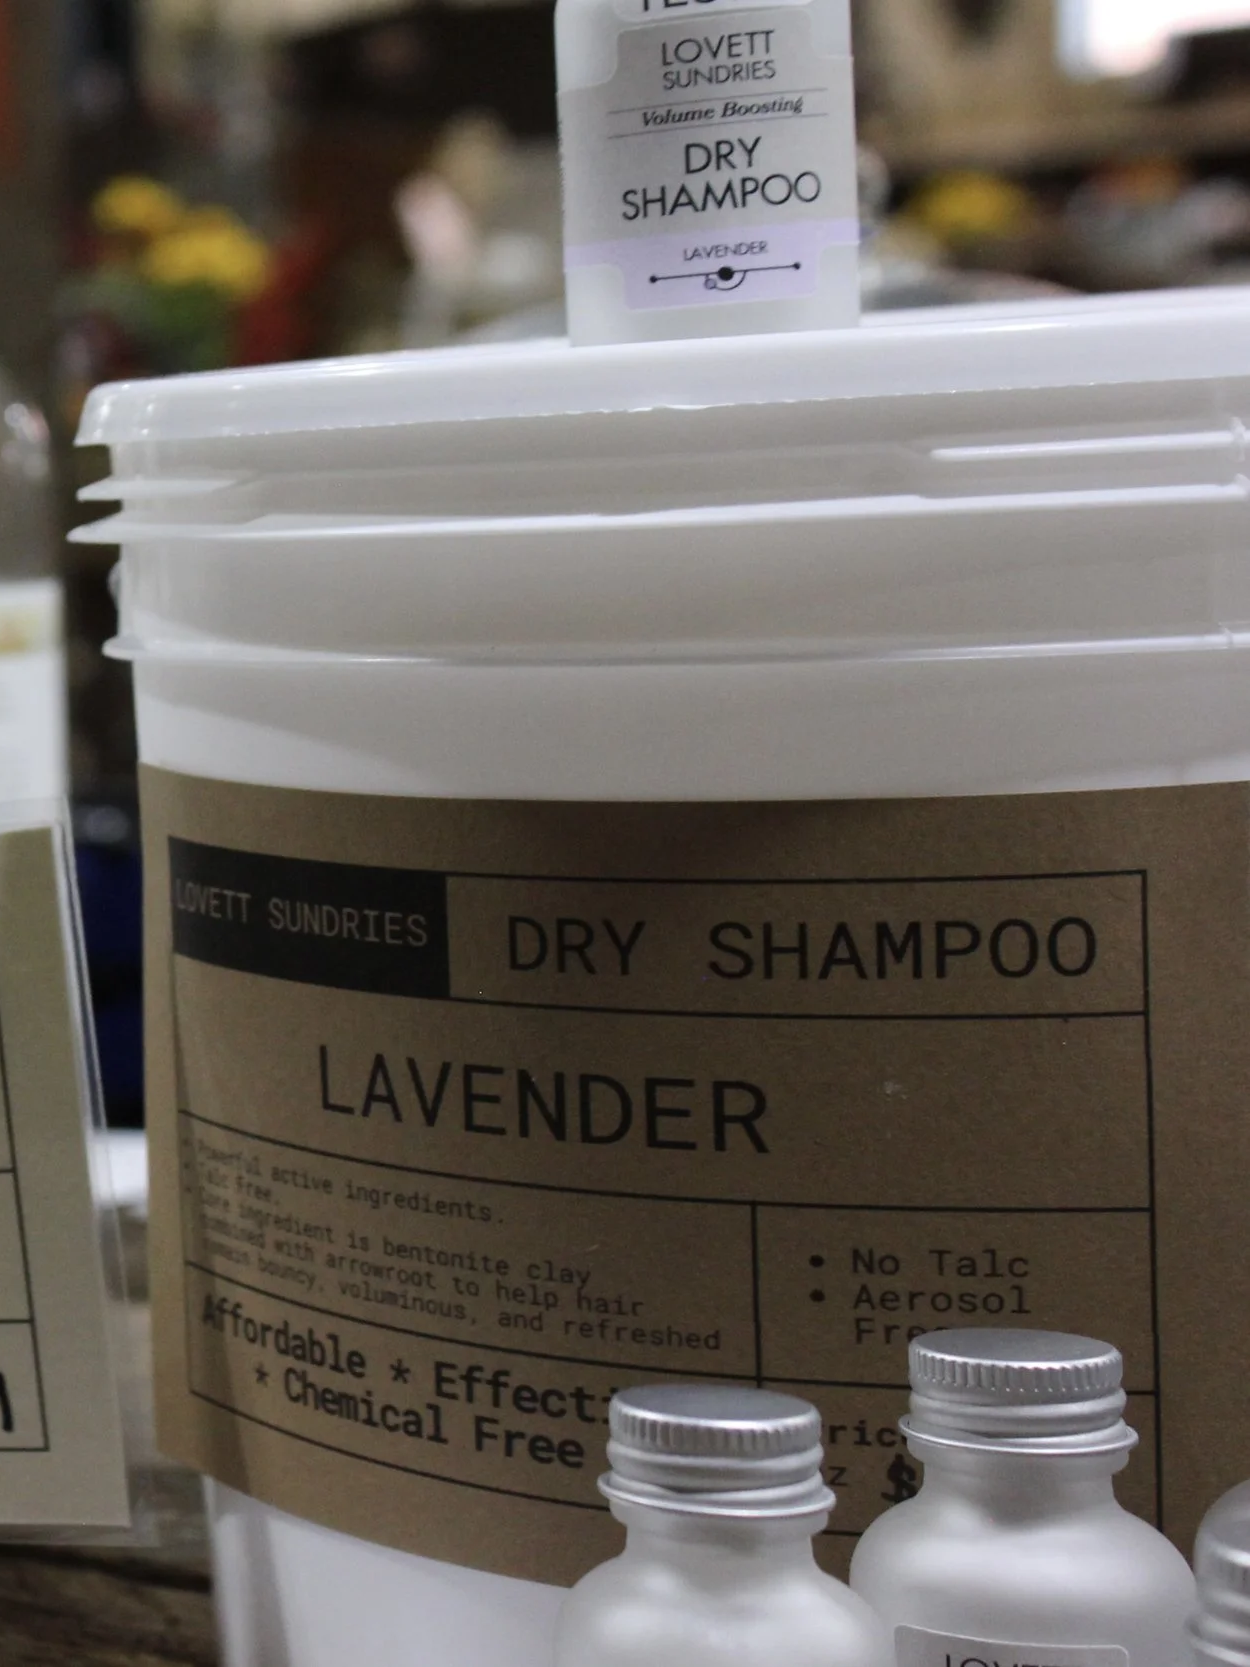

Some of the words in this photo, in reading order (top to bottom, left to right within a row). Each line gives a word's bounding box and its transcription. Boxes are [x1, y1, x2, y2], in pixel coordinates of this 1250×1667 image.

[661, 29, 775, 66] LOVETT
[662, 60, 776, 91] SUNDRIES
[642, 106, 715, 128] Volume
[721, 96, 804, 119] Boosting
[685, 136, 762, 175] DRY
[622, 171, 822, 221] SHAMPOO
[683, 240, 769, 262] LAVENDER
[175, 876, 253, 925] LOVETT
[267, 897, 429, 949] SUNDRIES
[507, 914, 648, 977] DRY
[706, 916, 1099, 982] SHAMPOO
[316, 1042, 773, 1156] LAVENDER
[271, 1165, 334, 1196] active
[345, 1180, 506, 1224] ingredients.
[273, 1238, 316, 1264] with
[325, 1250, 437, 1291] arrowroot
[453, 1274, 481, 1297] to
[495, 1277, 560, 1308] help
[576, 1286, 646, 1318] hair
[348, 1230, 370, 1252] is
[383, 1236, 511, 1278] bentonite
[526, 1257, 592, 1291] clay
[852, 1248, 900, 1278] No
[929, 1248, 1031, 1279] Talc
[338, 1279, 479, 1327] voluminous,
[498, 1309, 544, 1333] and
[562, 1317, 723, 1352] refreshed
[852, 1284, 1032, 1315] Aerosol
[201, 1292, 367, 1381] Affordable
[854, 1317, 948, 1345] Fre
[282, 1366, 449, 1446] Chemical
[474, 1415, 586, 1469] Free
[826, 1419, 908, 1448] ric
[828, 1465, 849, 1486] z
